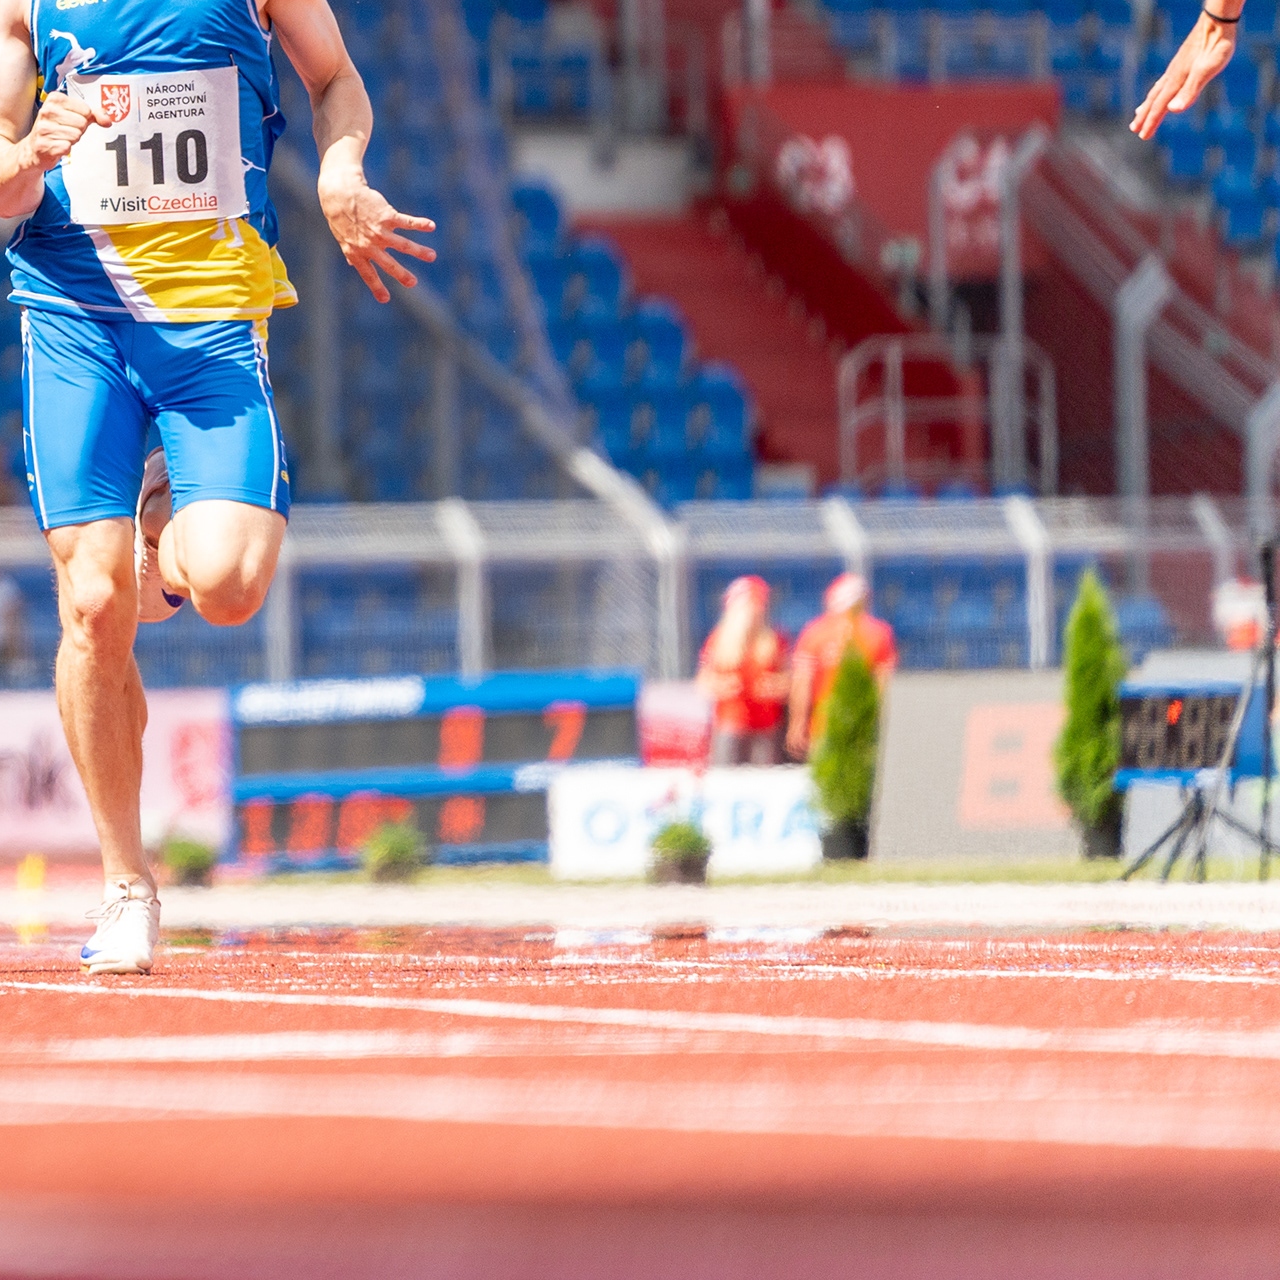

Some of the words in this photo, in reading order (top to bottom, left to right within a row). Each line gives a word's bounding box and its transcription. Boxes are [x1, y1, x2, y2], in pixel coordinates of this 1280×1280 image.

[146, 81, 195, 95] NÁRODNÍ
[146, 92, 207, 108] SPORTOVNÍ
[147, 108, 205, 120] AGENTURA
[104, 129, 209, 187] 110
[99, 192, 219, 215] #VisitCzechia
